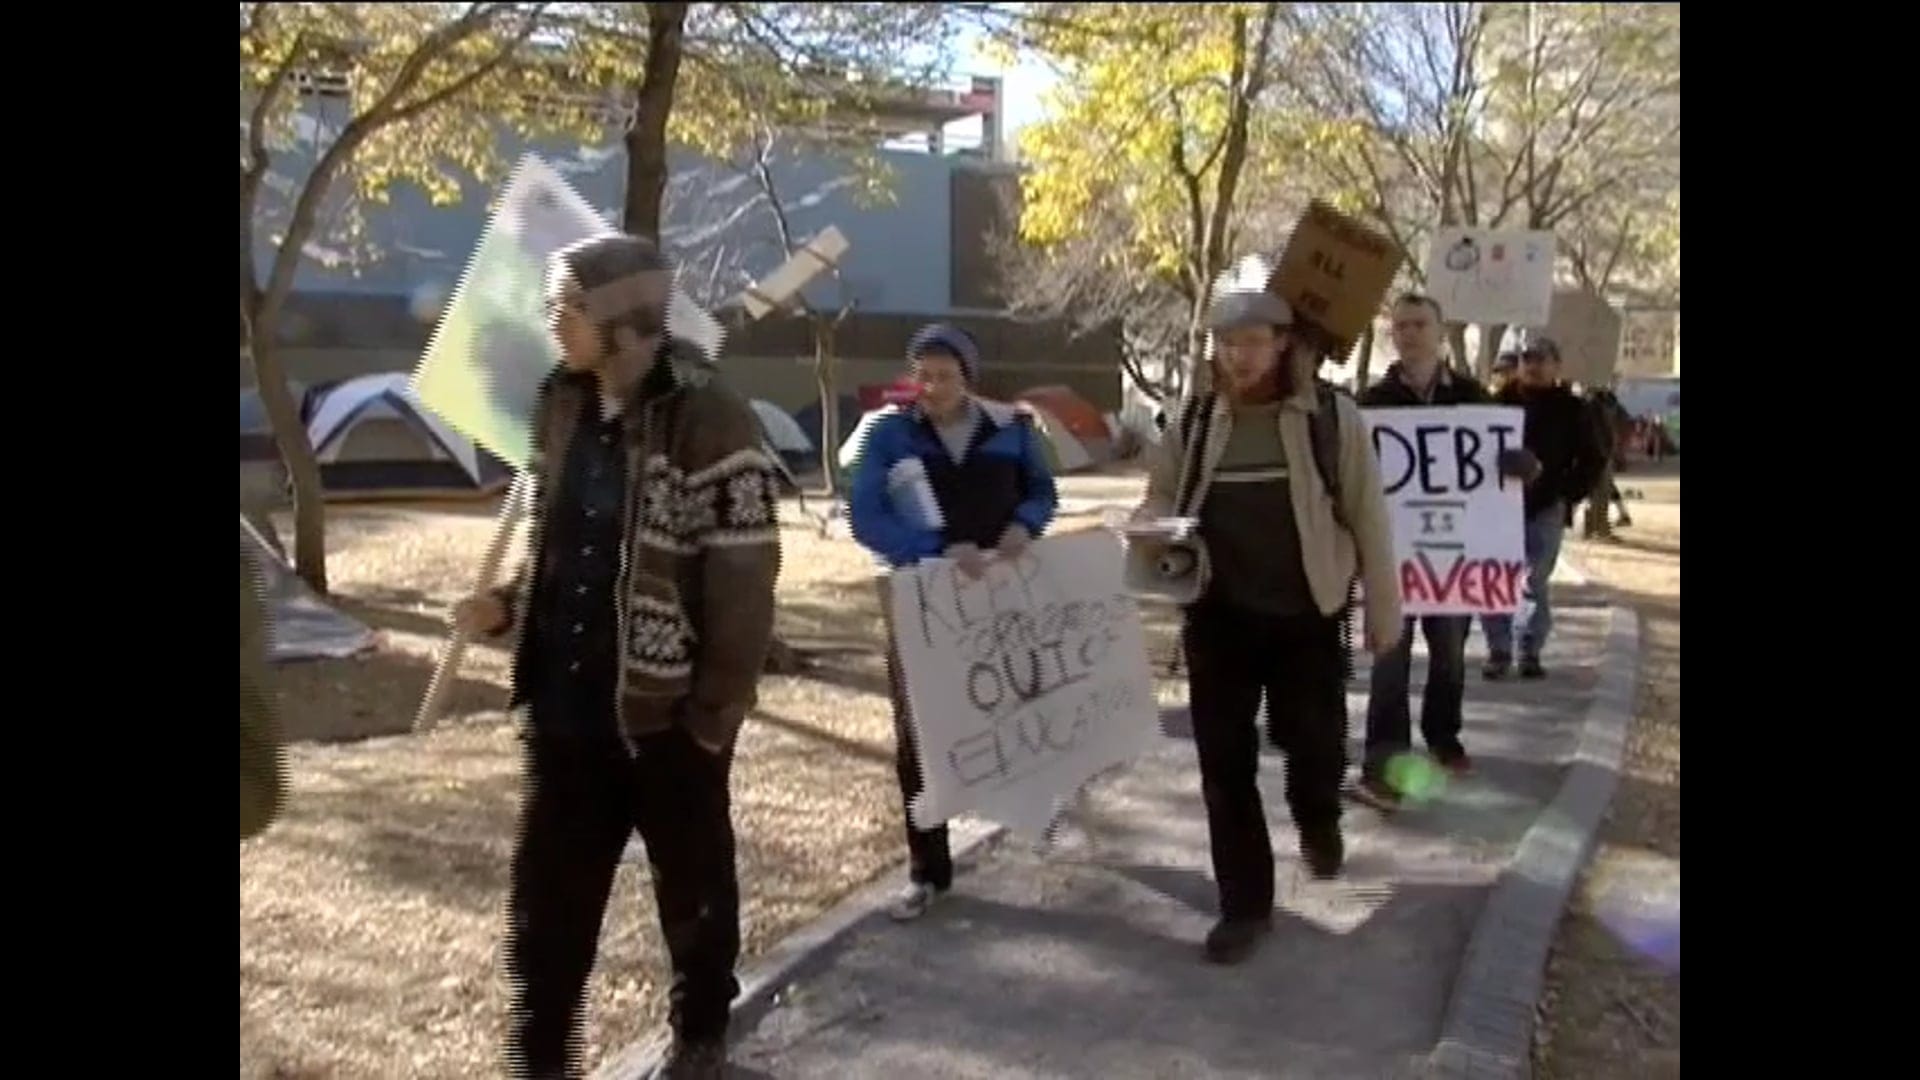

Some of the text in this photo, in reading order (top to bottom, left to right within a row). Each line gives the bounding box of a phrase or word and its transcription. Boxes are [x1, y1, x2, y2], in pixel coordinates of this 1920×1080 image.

[1372, 423, 1516, 494] DEBT
[1420, 511, 1455, 534] IS
[1401, 551, 1522, 609] AVERY
[966, 640, 1070, 713] OUT
